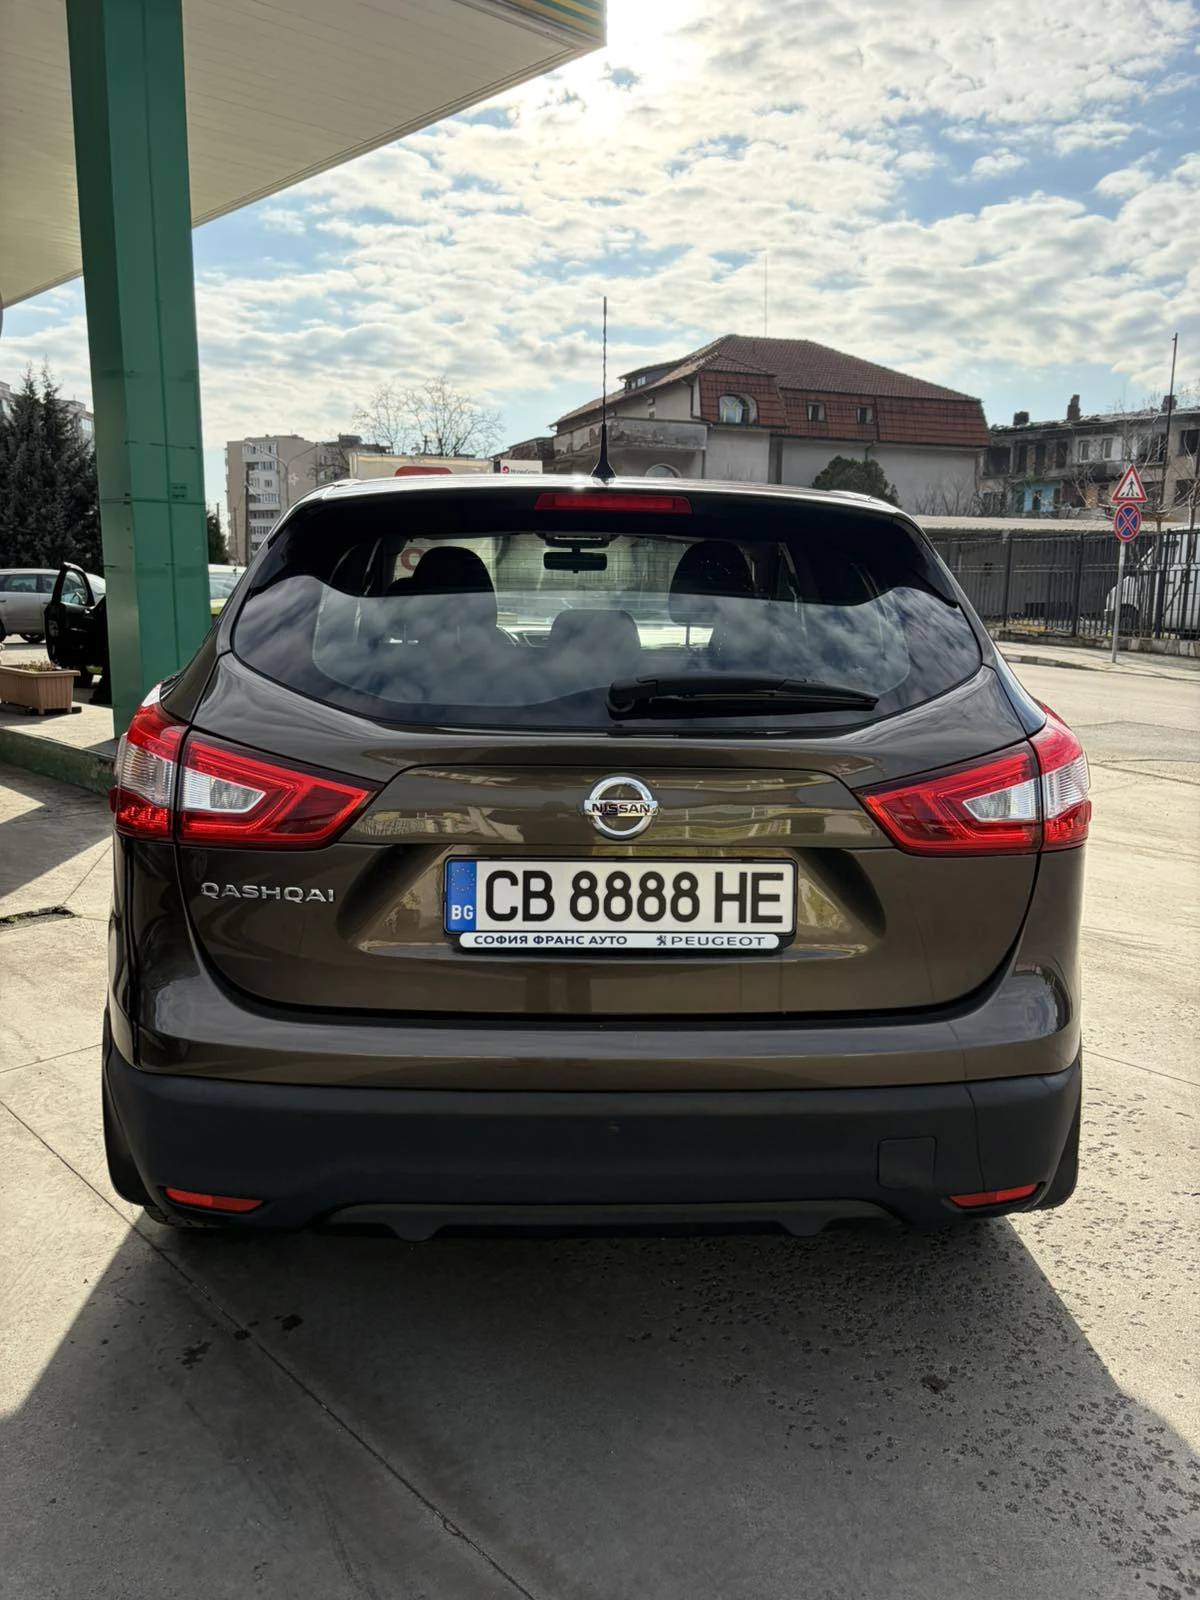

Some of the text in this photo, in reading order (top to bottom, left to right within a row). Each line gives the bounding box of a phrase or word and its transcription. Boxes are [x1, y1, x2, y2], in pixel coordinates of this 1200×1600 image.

[592, 803, 651, 814] NISSAN
[201, 882, 335, 903] QASHQAI
[485, 869, 784, 924] CB 8888 HE
[451, 904, 474, 920] BG
[474, 935, 628, 945] СОФИЯ ФРАНС АУТО
[671, 936, 766, 946] PEUGEOT
